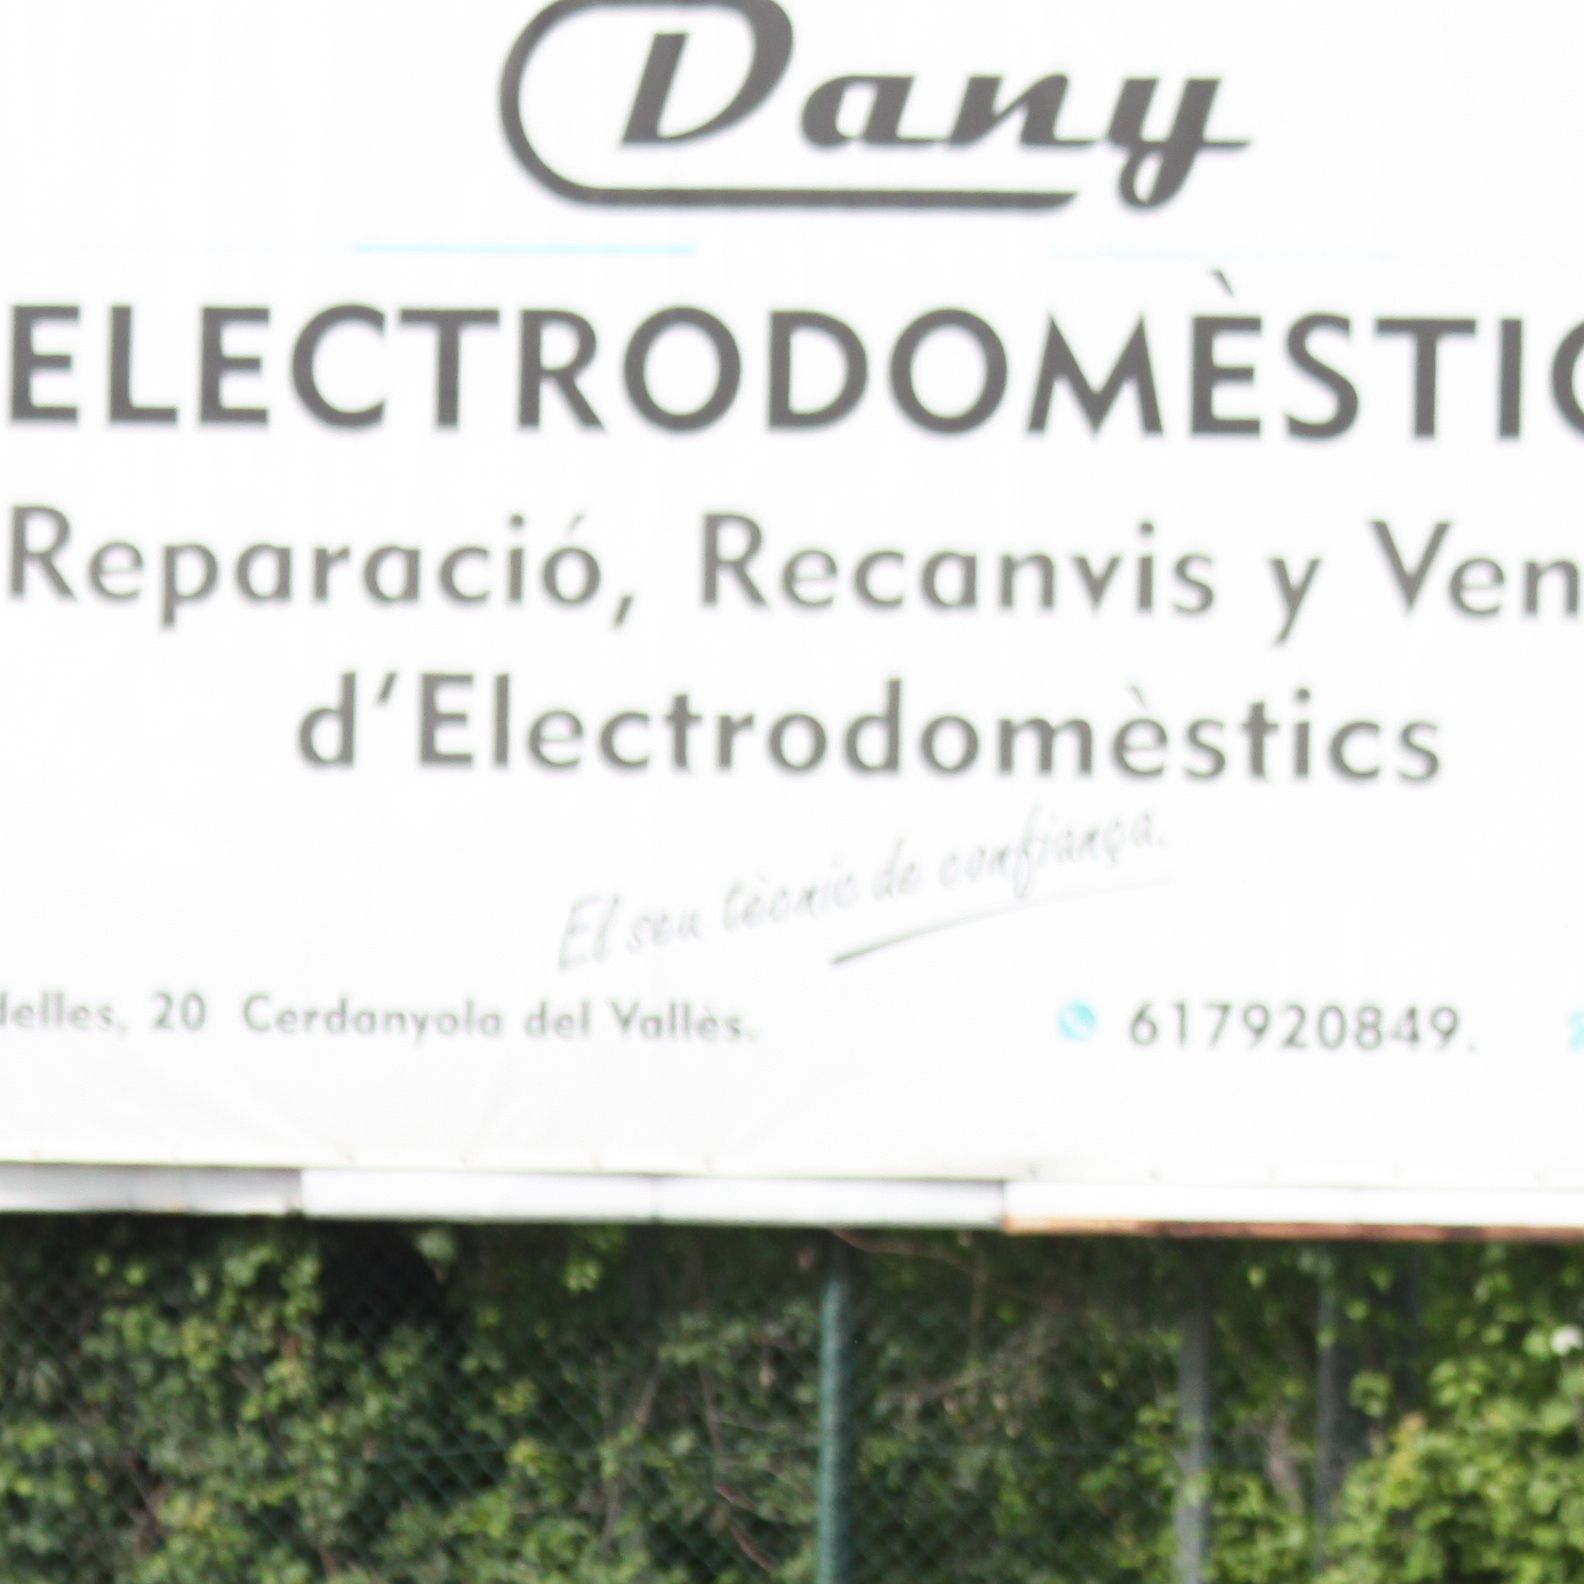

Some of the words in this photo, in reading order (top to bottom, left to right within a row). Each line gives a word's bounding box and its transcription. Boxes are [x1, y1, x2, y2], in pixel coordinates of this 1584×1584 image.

[497, 0, 1252, 213] Dany
[8, 504, 634, 630] Reparació,
[701, 511, 1216, 616] Recanvis
[1268, 556, 1322, 646] y
[297, 670, 1441, 784] d'Electrodomèstics
[557, 892, 622, 972] El
[624, 908, 702, 952] seu
[871, 834, 924, 902] de
[151, 988, 209, 1034] 20
[240, 990, 504, 1043] Cerdanyola
[522, 997, 593, 1039] del
[1127, 998, 1479, 1055] 617920849.
